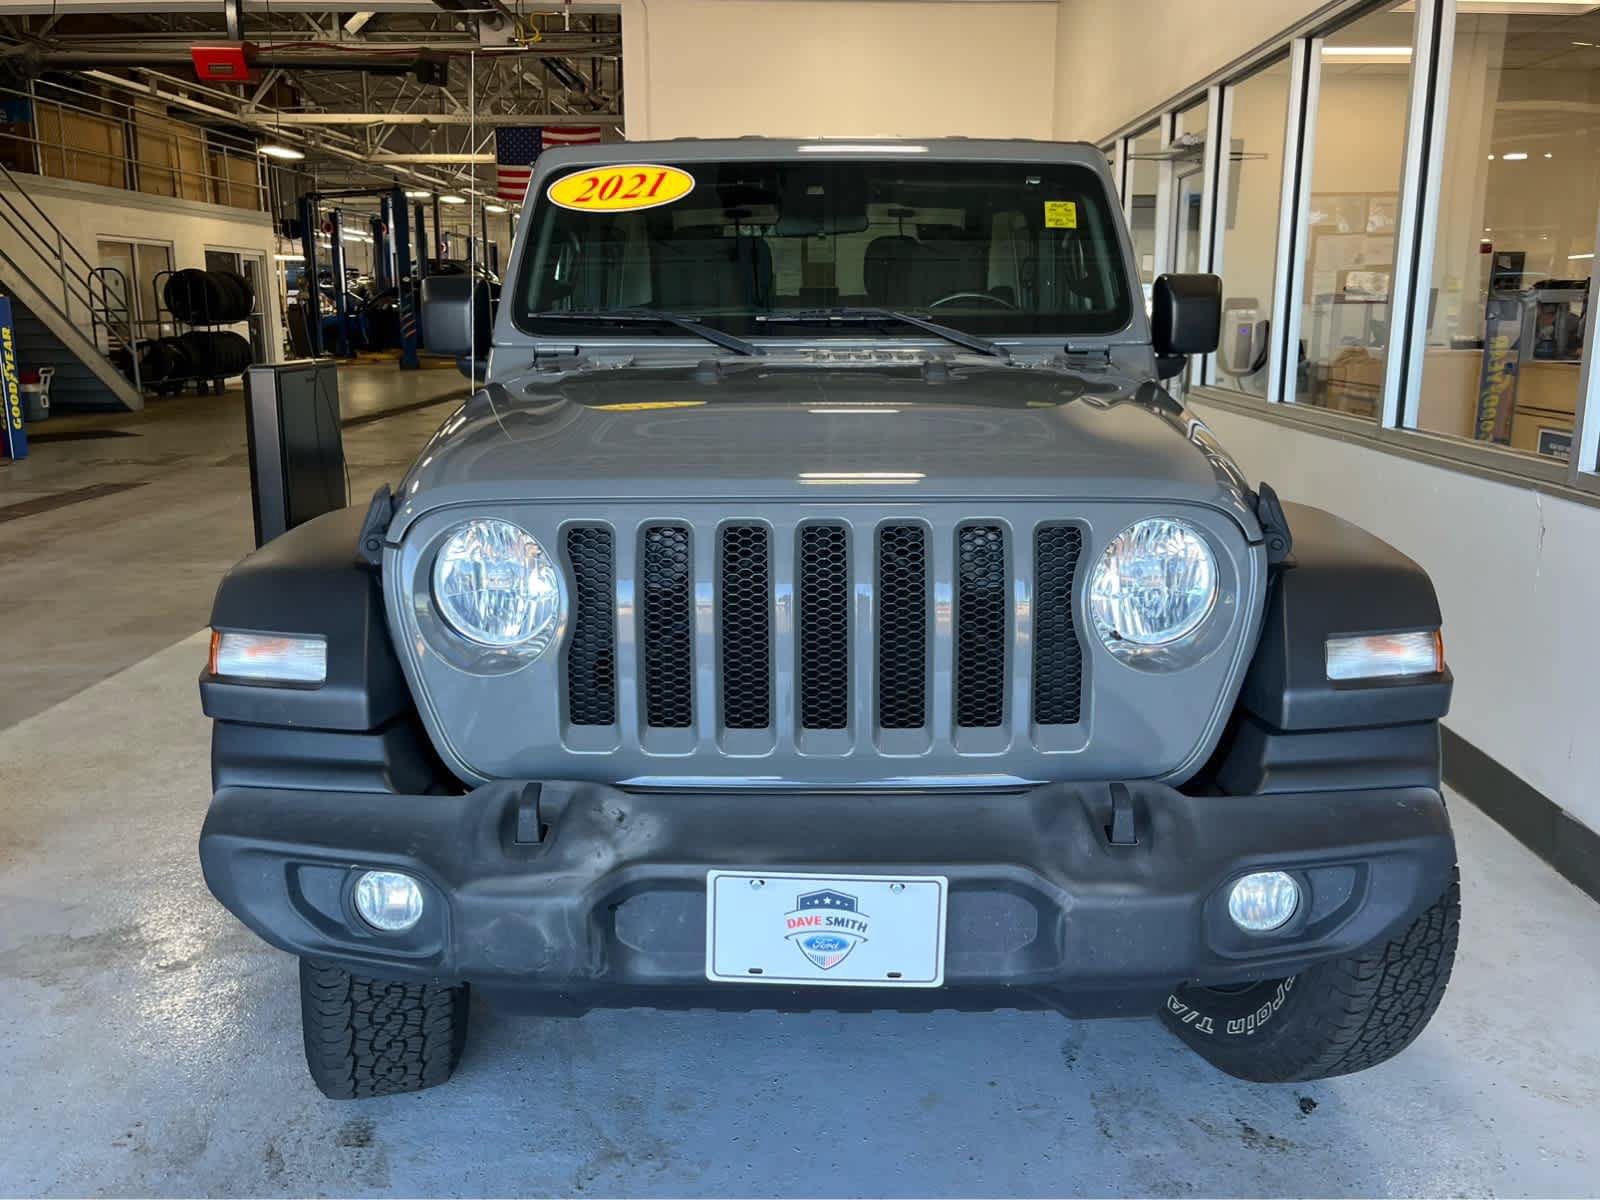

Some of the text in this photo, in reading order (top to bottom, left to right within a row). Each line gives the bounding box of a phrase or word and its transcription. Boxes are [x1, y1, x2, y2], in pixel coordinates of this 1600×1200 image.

[572, 171, 668, 203] 2021
[2, 327, 22, 430] GOODYEAR
[786, 915, 868, 933] DAVE SMITH
[811, 936, 841, 952] Ford
[1167, 994, 1215, 1035] T/A
